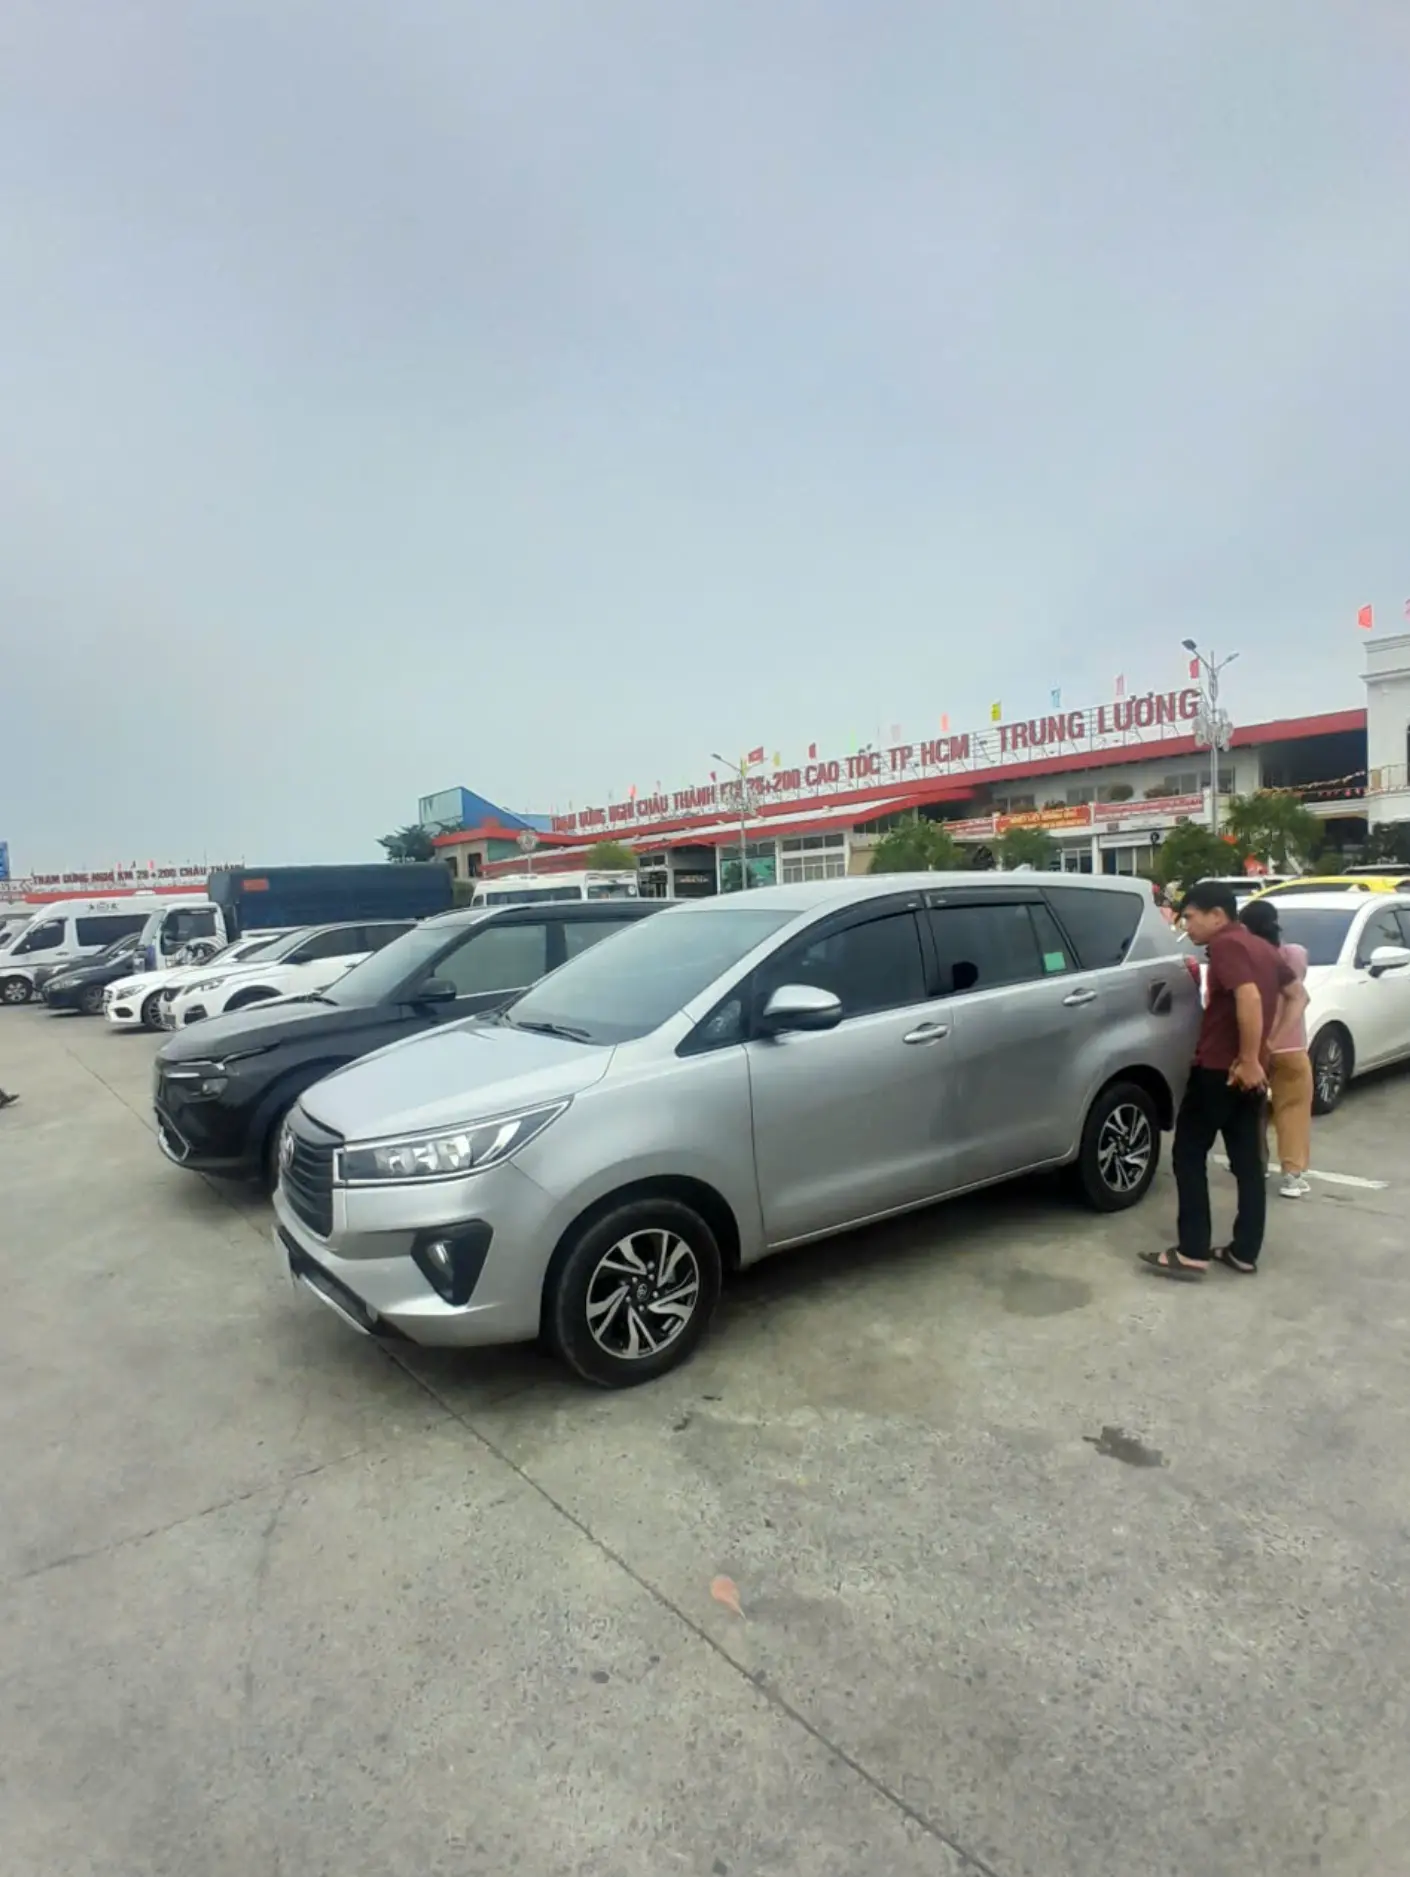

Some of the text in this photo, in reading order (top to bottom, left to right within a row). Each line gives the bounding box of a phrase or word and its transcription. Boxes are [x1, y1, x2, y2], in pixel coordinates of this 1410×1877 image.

[804, 760, 840, 787] CAO
[845, 743, 881, 779] TỐC
[996, 711, 1084, 752] TRUNG
[1097, 687, 1201, 734] LƯƠNG
